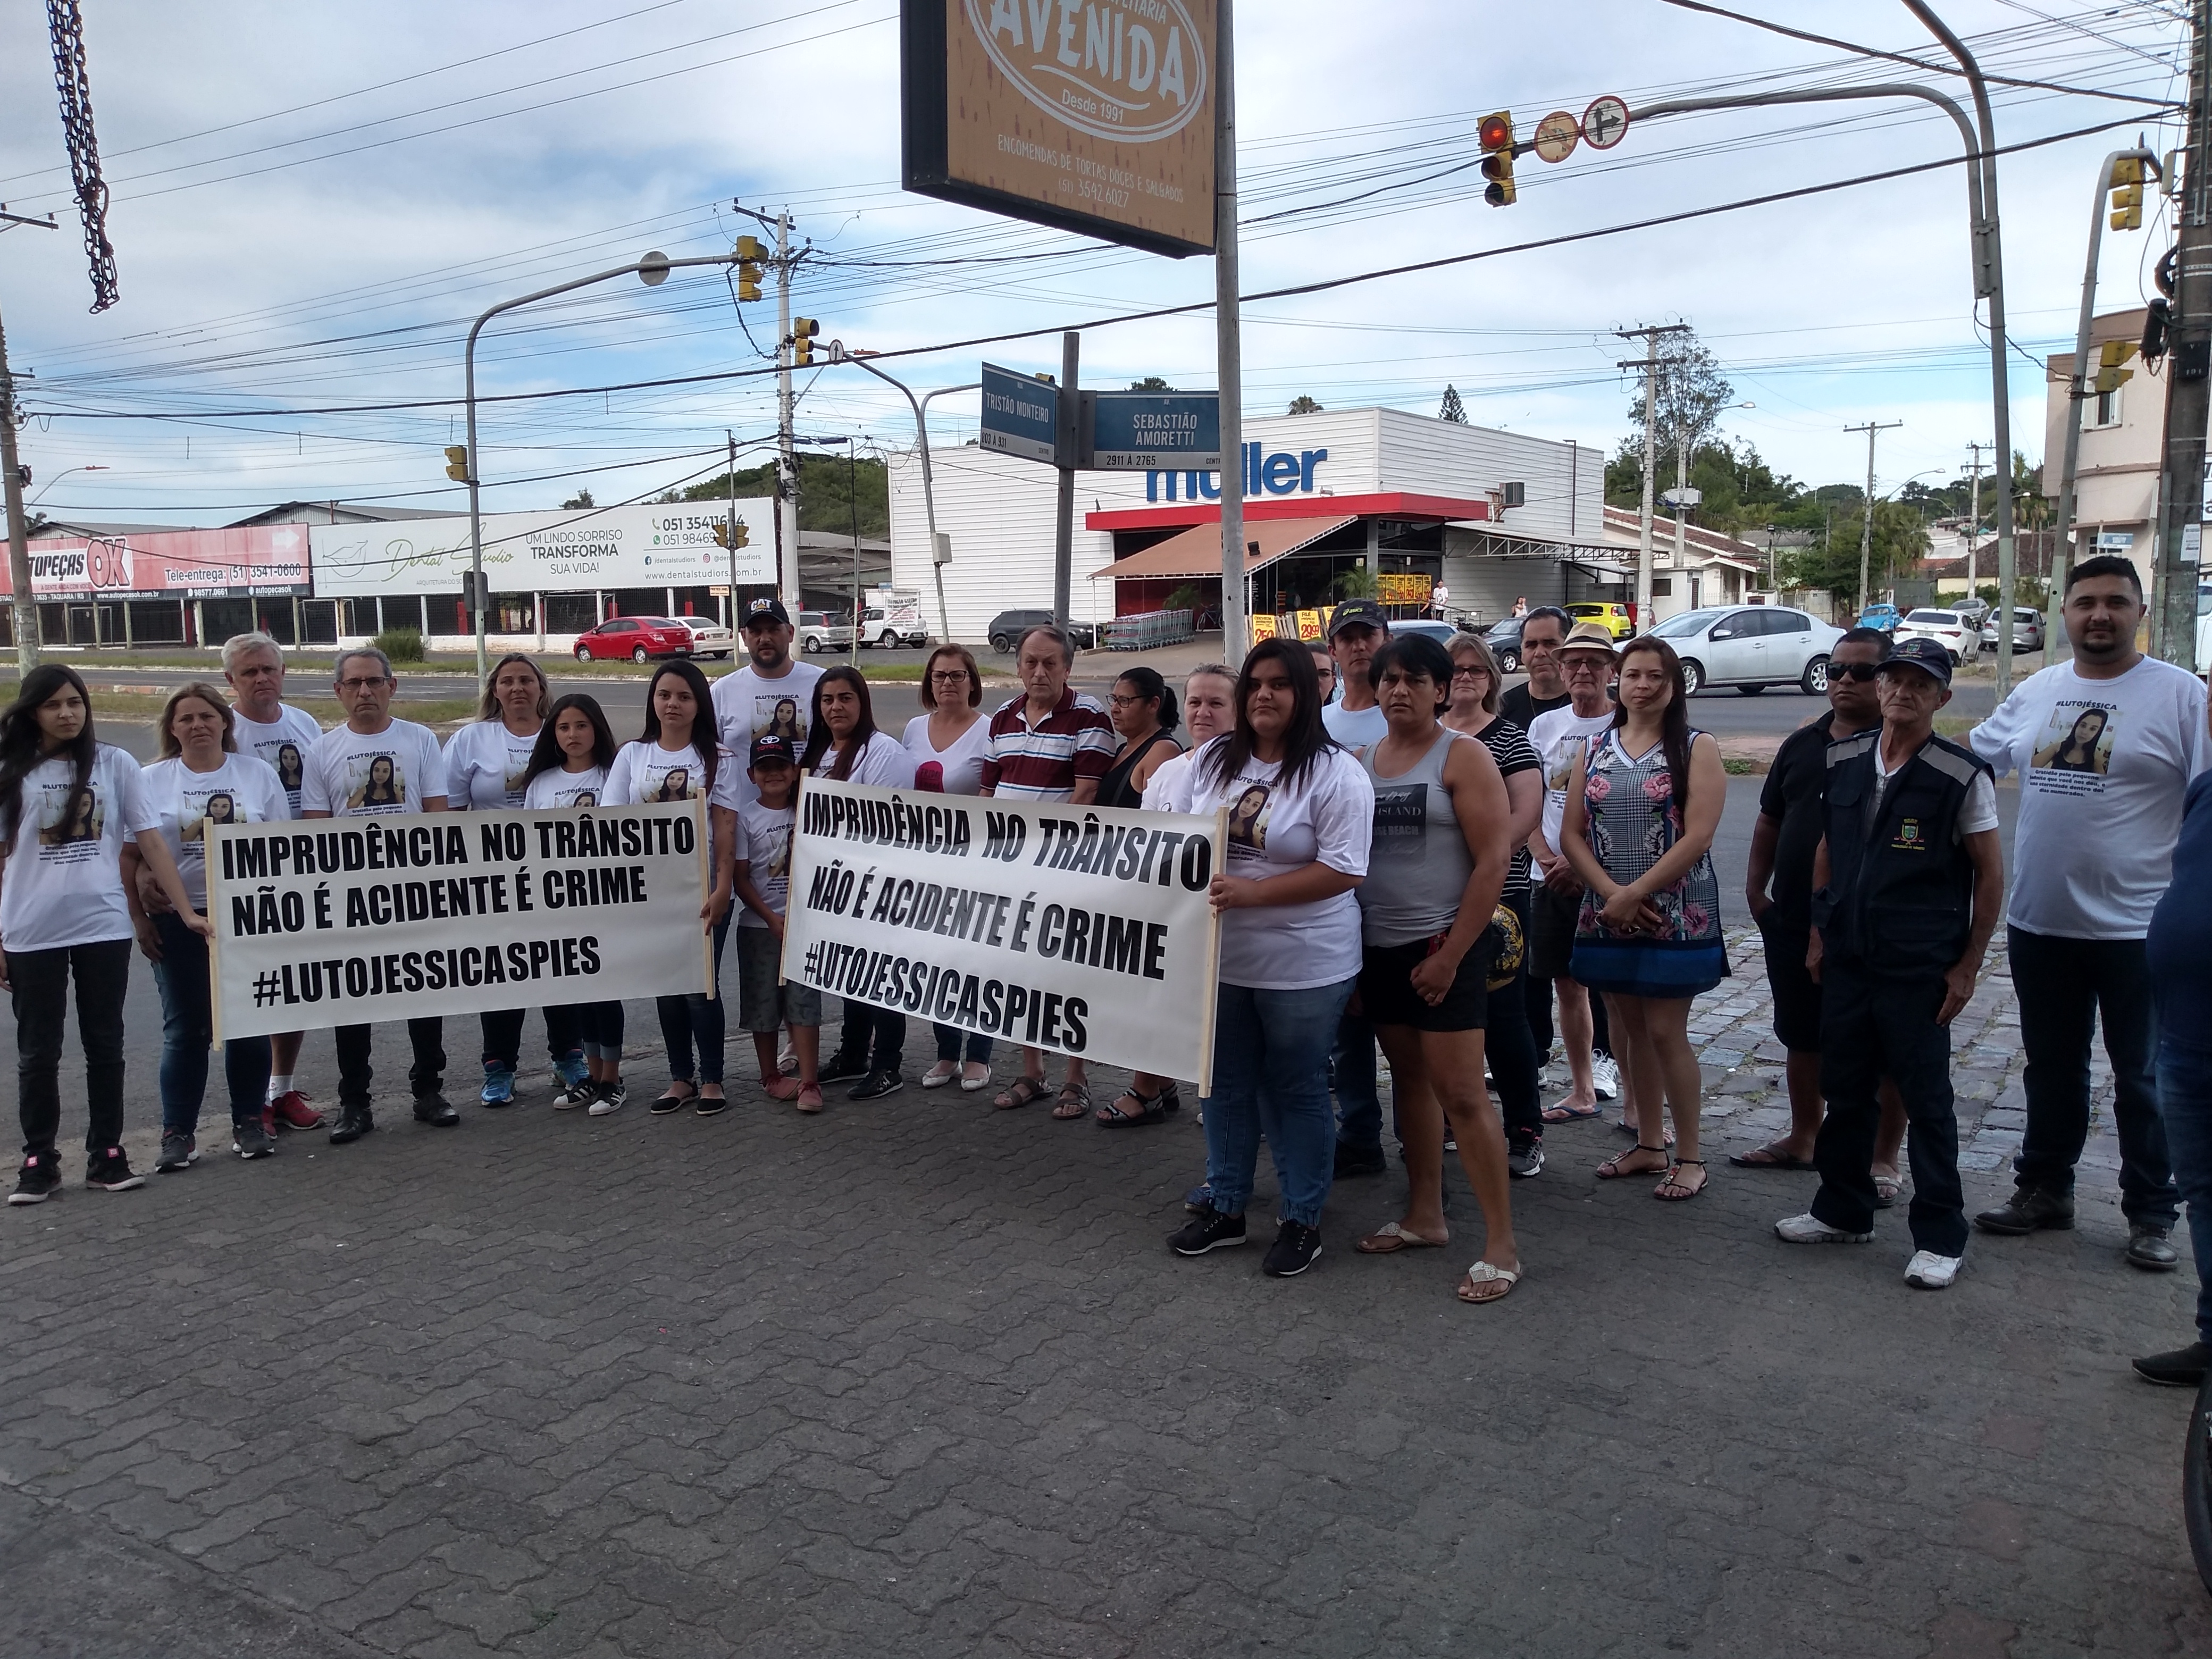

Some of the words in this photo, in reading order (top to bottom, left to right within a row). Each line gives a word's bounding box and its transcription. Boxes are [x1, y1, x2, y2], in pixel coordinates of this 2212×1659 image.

[989, 0, 1186, 107] AVENIDA
[1062, 89, 1097, 114] Desde
[1100, 99, 1124, 123] 1991
[998, 134, 1057, 166] ENCOMENDAS
[1061, 153, 1071, 171] DE
[1075, 157, 1107, 181] TORTAS
[1110, 168, 1134, 189] DOCES
[1137, 176, 1143, 191] E
[1146, 179, 1184, 203] SALGADOS
[1059, 178, 1074, 194] (51)
[986, 392, 1014, 415] TRISTÃO
[1017, 400, 1049, 423] MONTEIRO
[1133, 412, 1197, 429] SEBASTIÃO
[982, 432, 991, 445] 803
[998, 436, 1007, 448] 931
[1135, 431, 1195, 446] AMORETTI
[1107, 455, 1124, 466] 2911
[1127, 454, 1133, 466] À
[1136, 456, 1156, 466] 2765
[663, 518, 683, 531] 051
[686, 514, 745, 530] 3541164
[526, 533, 541, 544] UM
[544, 532, 576, 544] LINDO
[577, 529, 623, 542] SORRISO
[663, 534, 680, 546] 051
[531, 543, 619, 559] TRANSFORMA
[714, 554, 761, 563] @denlstudiors
[87, 539, 130, 588] OK
[381, 539, 447, 582] Dental
[550, 564, 571, 574] SUA
[572, 562, 600, 574] VIDA!
[165, 568, 227, 583] Tele-entrega:
[230, 566, 248, 582] (51)
[645, 567, 762, 580] www.dentalstudiors.om.br
[97, 591, 159, 599] www.autopecasok.com.br
[194, 588, 228, 597] 98577.0661
[255, 585, 292, 594] autopecasok
[751, 598, 772, 611] CAT
[2055, 700, 2117, 710] #LUTOJÉSSICA
[254, 739, 298, 748] #LUTOJÉSSICA
[756, 744, 783, 752] TOYOTA
[347, 750, 397, 761] #LUTOJÉSSICA
[555, 787, 600, 796] #LUTOJÉSSICA
[1378, 807, 1421, 816] ISLAND
[222, 823, 468, 880] IMPRUDÊNCIA
[481, 822, 526, 862] NO
[534, 813, 694, 859] TRÂNSITO
[802, 792, 971, 857] IMPRUDÊNCIA
[981, 810, 1027, 863] NO
[1033, 812, 1212, 892] TRÂNSITO
[232, 884, 305, 937] NÃO
[314, 881, 333, 929] É
[346, 874, 509, 928] ACIDENTE
[515, 866, 534, 912] É
[542, 866, 648, 909] CRIME
[807, 859, 855, 916] NÃO
[851, 866, 878, 919] É
[869, 875, 1012, 948] ACIDENTE
[1010, 891, 1037, 953] É
[1037, 903, 1169, 981] CRIME
[252, 935, 601, 1008] #LUTOJESSICASPIES
[804, 940, 1088, 1053] #LUTOJESSICASPIES
